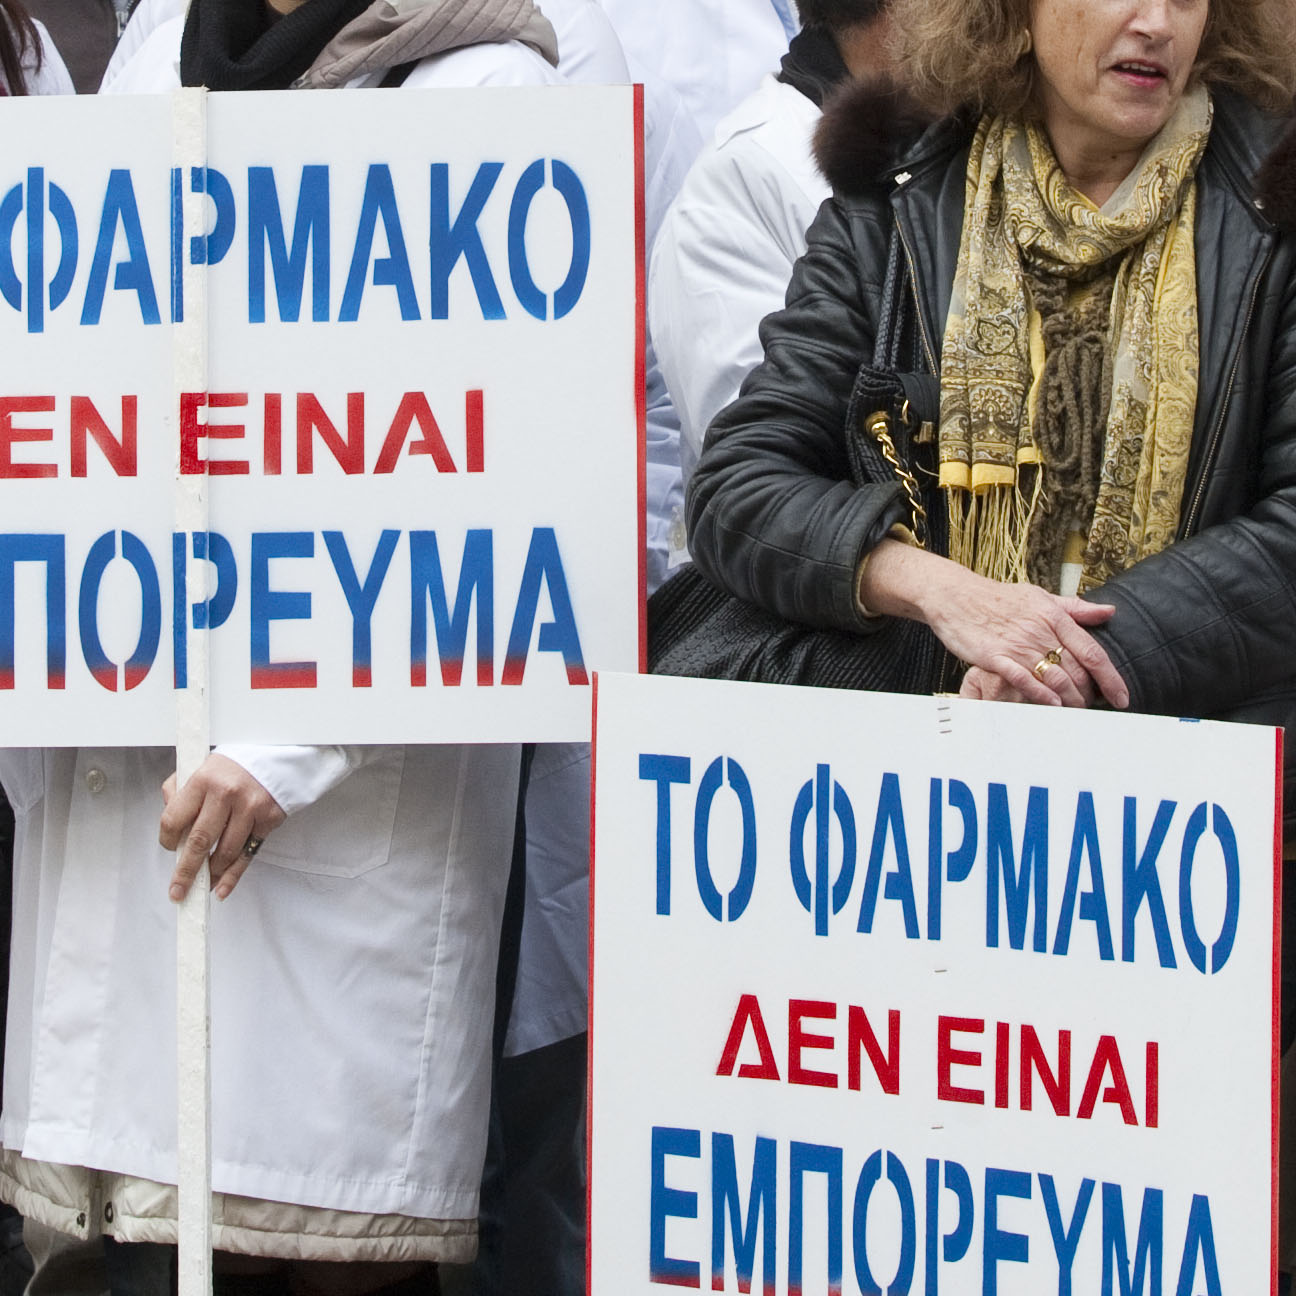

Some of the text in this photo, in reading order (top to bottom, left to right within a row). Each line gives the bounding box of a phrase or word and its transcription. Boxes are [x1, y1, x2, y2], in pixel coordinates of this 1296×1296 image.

[180, 389, 484, 475] ΕΙΝΑΙ
[638, 754, 1240, 974] ΤΟ ΦΑΡΜΑΚΟ
[716, 994, 1158, 1128] ΔΕΝ ΕΙΝΑΙ
